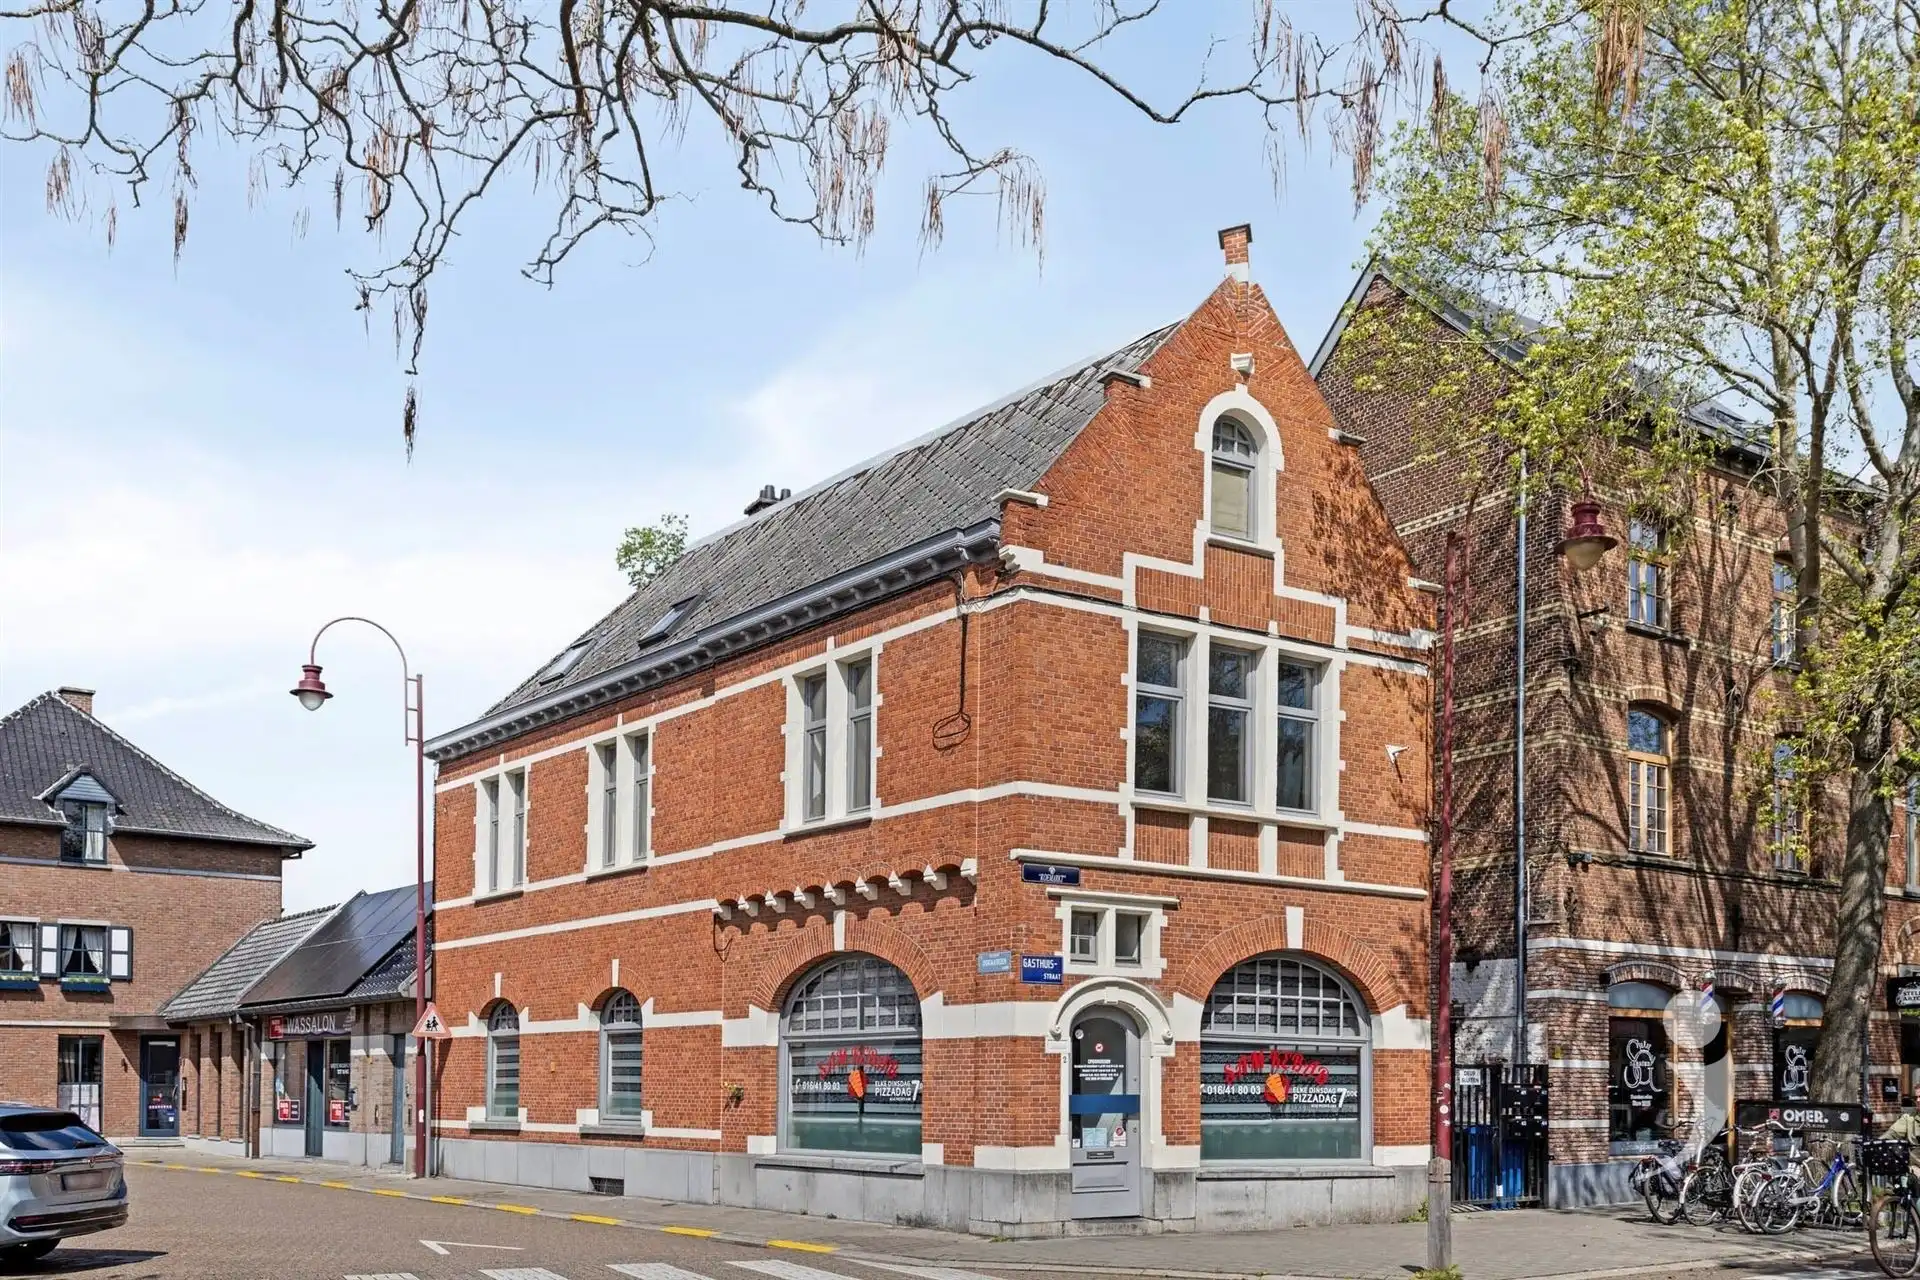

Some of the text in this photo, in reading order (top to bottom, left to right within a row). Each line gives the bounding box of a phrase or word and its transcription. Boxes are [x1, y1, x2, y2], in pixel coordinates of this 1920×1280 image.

[1022, 958, 1058, 969] GASTHUIS-
[287, 1014, 336, 1034] WASSALON
[874, 1087, 912, 1097] PIZZADAG
[1207, 1084, 1261, 1095] 016/41 80 03
[1292, 1093, 1337, 1104] PIZZADAG
[1783, 1109, 1829, 1123] OMER.
